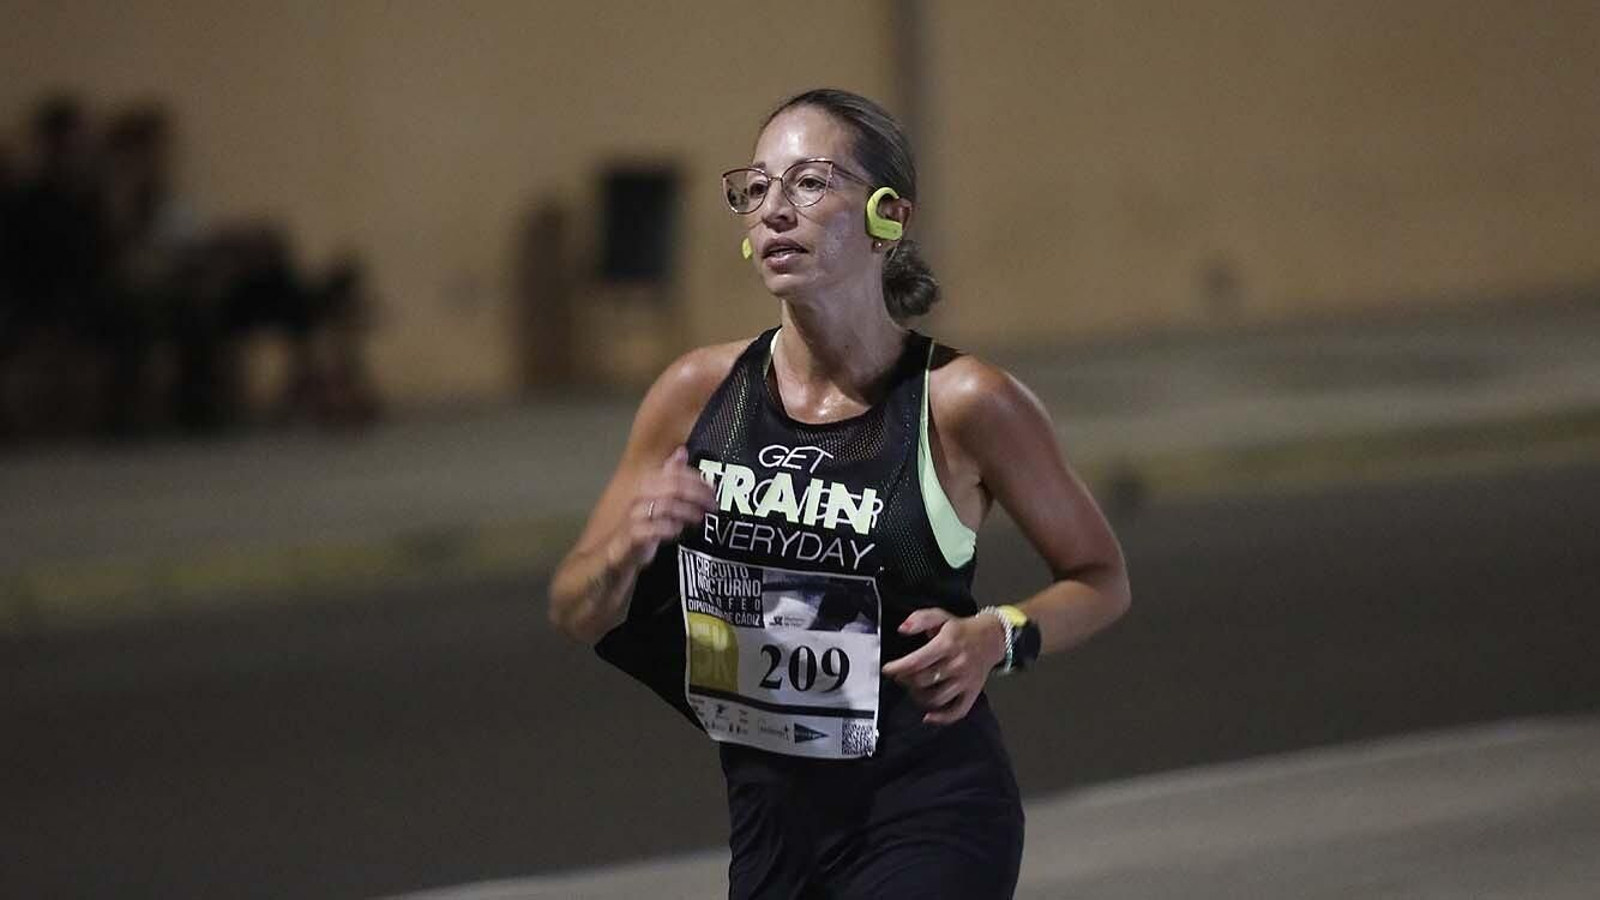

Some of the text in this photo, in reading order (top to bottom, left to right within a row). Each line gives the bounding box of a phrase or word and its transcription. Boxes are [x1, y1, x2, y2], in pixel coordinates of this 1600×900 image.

[758, 445, 834, 474] GET
[699, 459, 877, 535] TRAIN
[704, 512, 875, 570] EVERYDAY
[696, 556, 749, 579] CIRCUITO
[697, 573, 761, 597] NOCTURNO
[759, 644, 850, 692] 209
